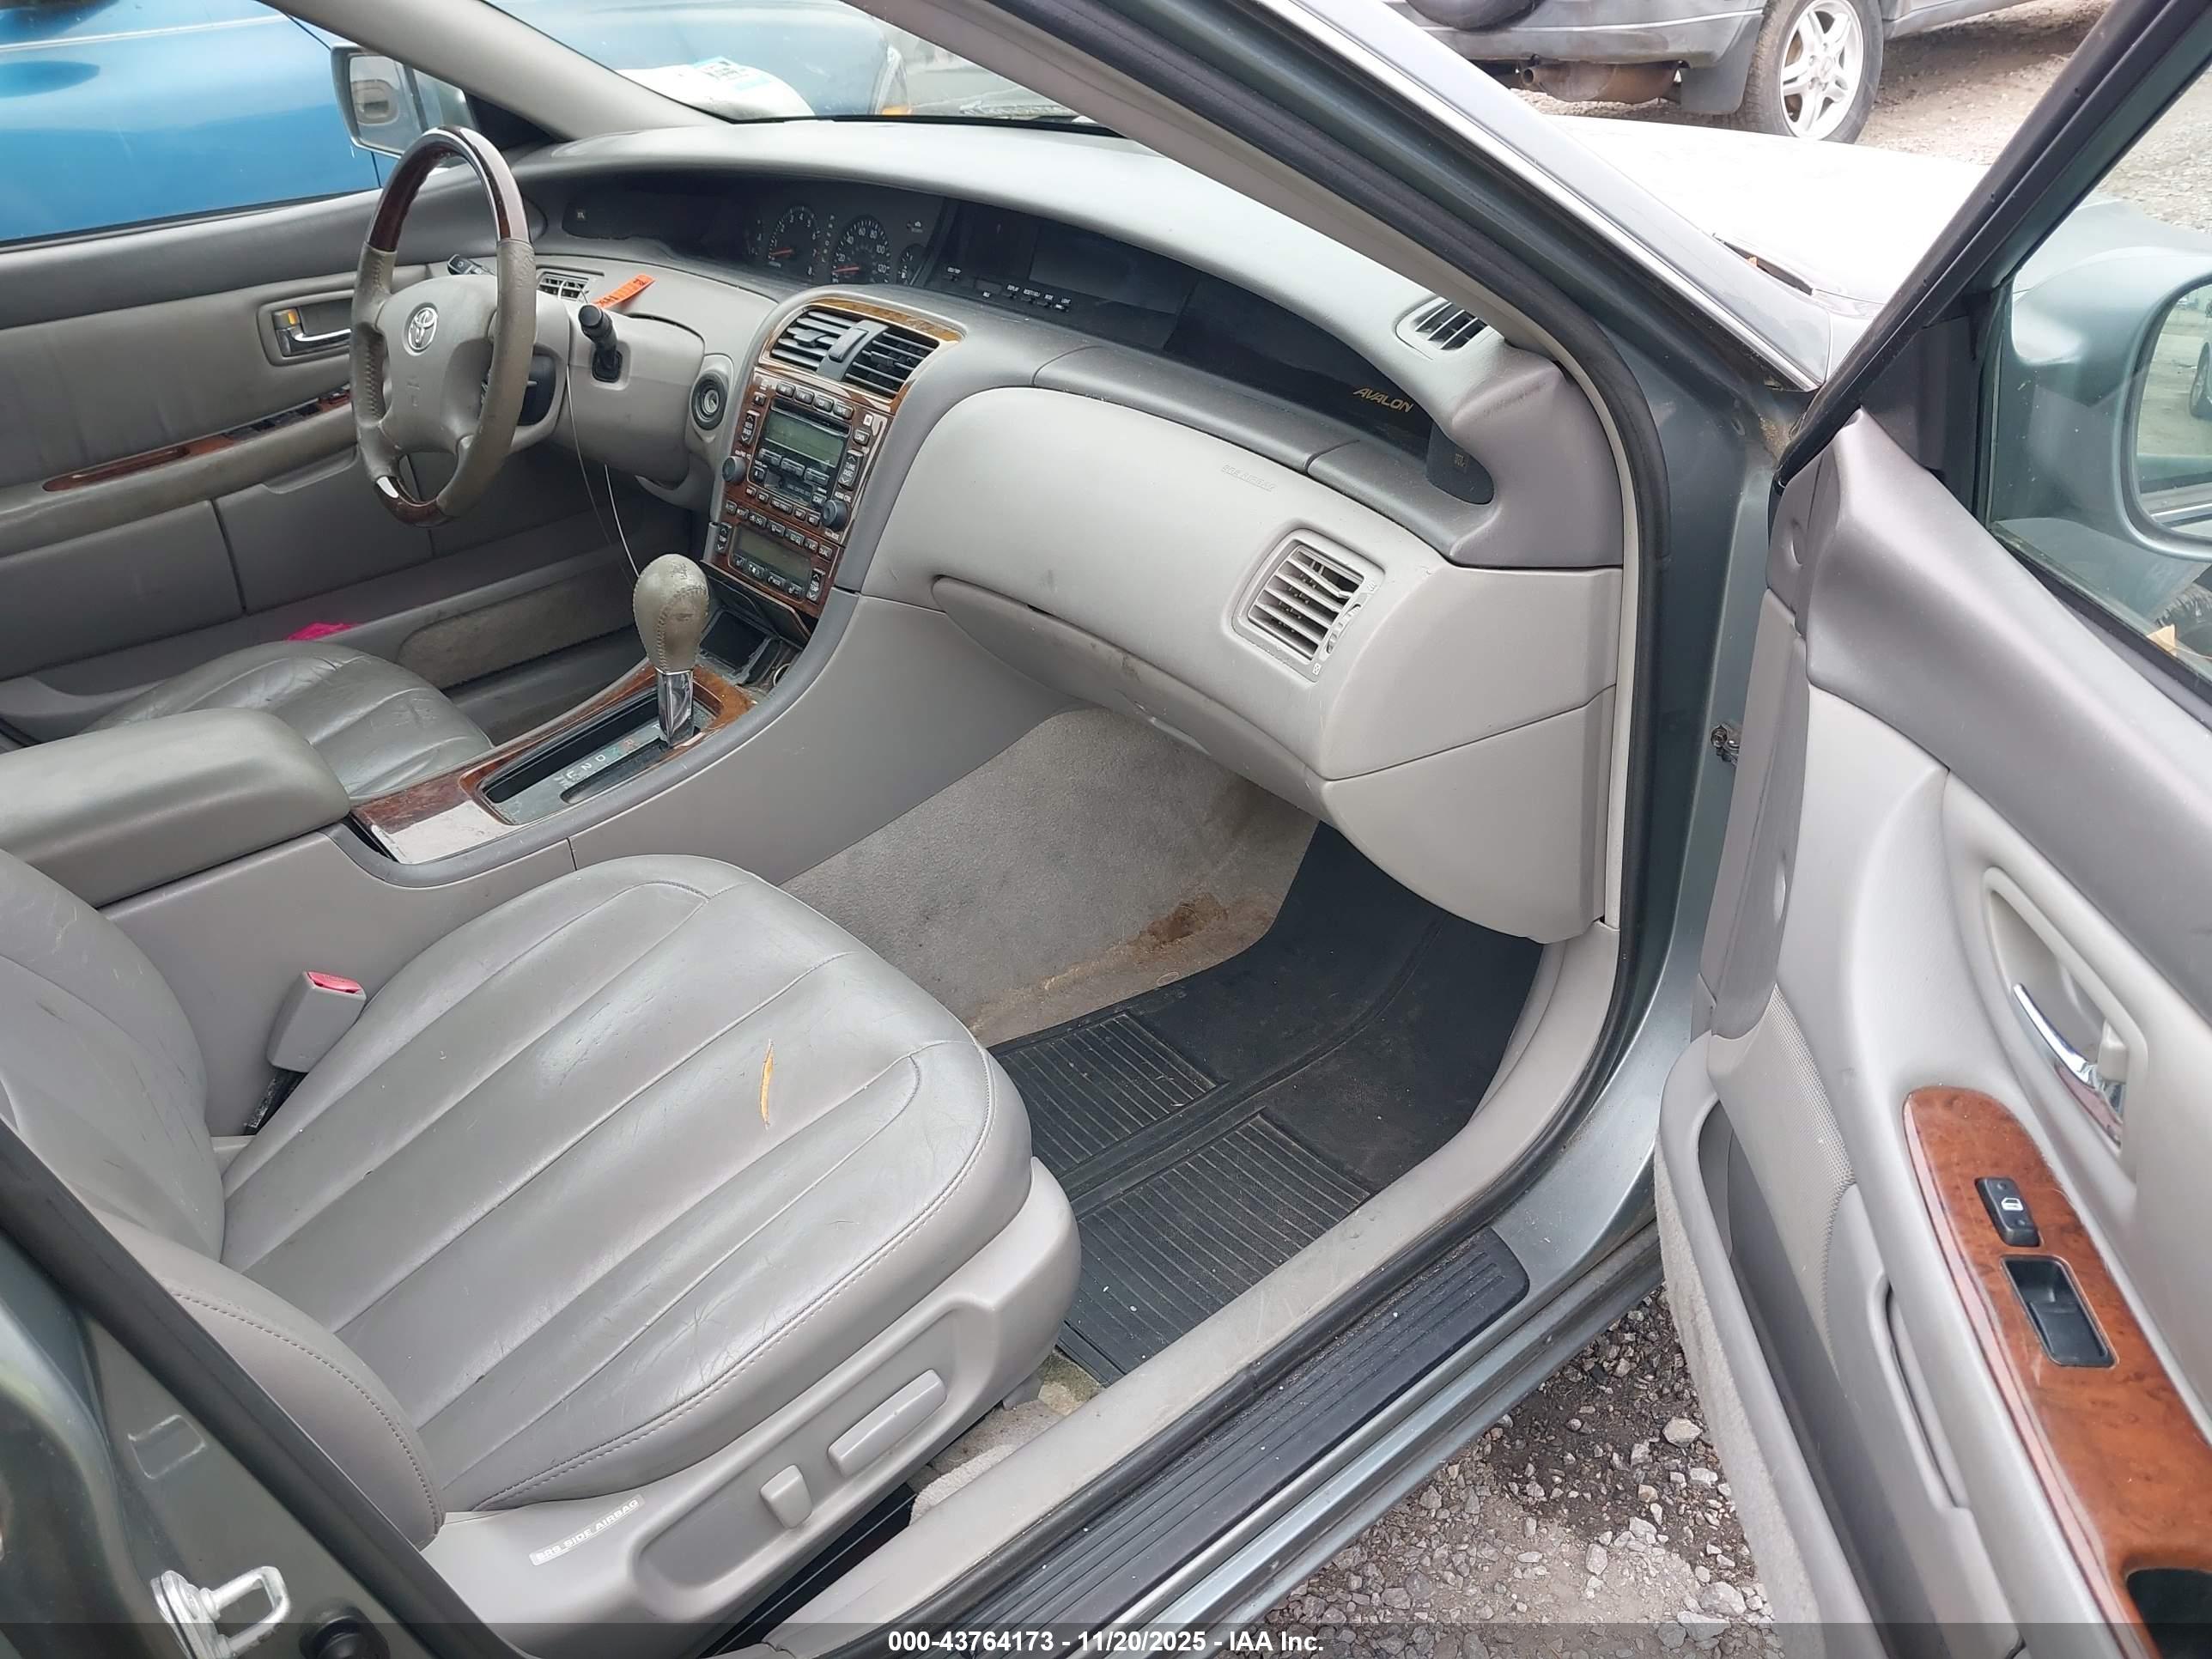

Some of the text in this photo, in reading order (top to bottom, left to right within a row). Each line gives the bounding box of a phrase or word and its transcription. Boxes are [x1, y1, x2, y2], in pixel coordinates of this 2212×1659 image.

[876, 244, 886, 255] 100
[837, 253, 846, 262] 20
[878, 264, 887, 274] 120
[1353, 387, 1414, 413] AVALON
[535, 1500, 640, 1561] SRS SIDE AIRBAG
